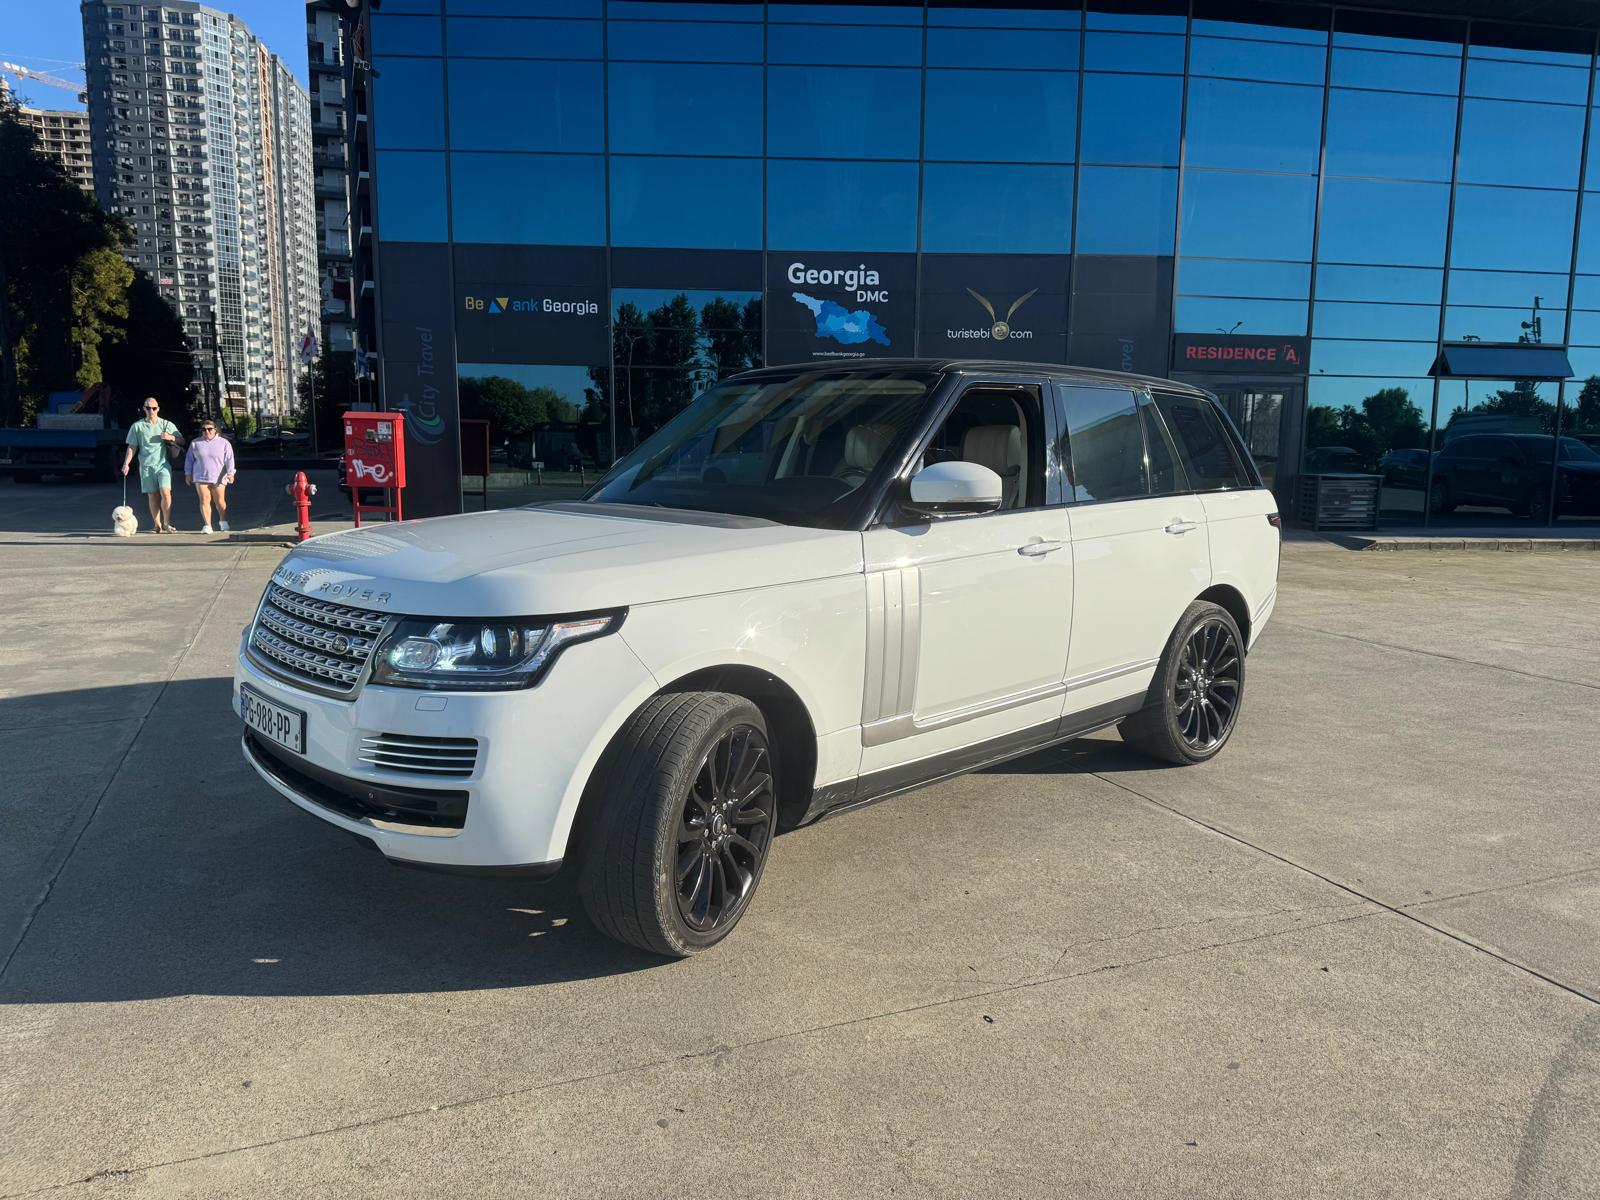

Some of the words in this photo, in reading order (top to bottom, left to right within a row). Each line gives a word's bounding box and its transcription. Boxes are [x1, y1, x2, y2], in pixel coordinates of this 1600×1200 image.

[788, 263, 879, 291] Georgia
[465, 296, 484, 310] Be
[512, 299, 539, 312] ank
[543, 299, 598, 315] Georgia
[857, 290, 889, 303] DMC
[416, 326, 434, 377] Travel
[1186, 346, 1276, 361] RESIDENCE
[418, 383, 440, 418] City
[319, 582, 392, 604] ROVER
